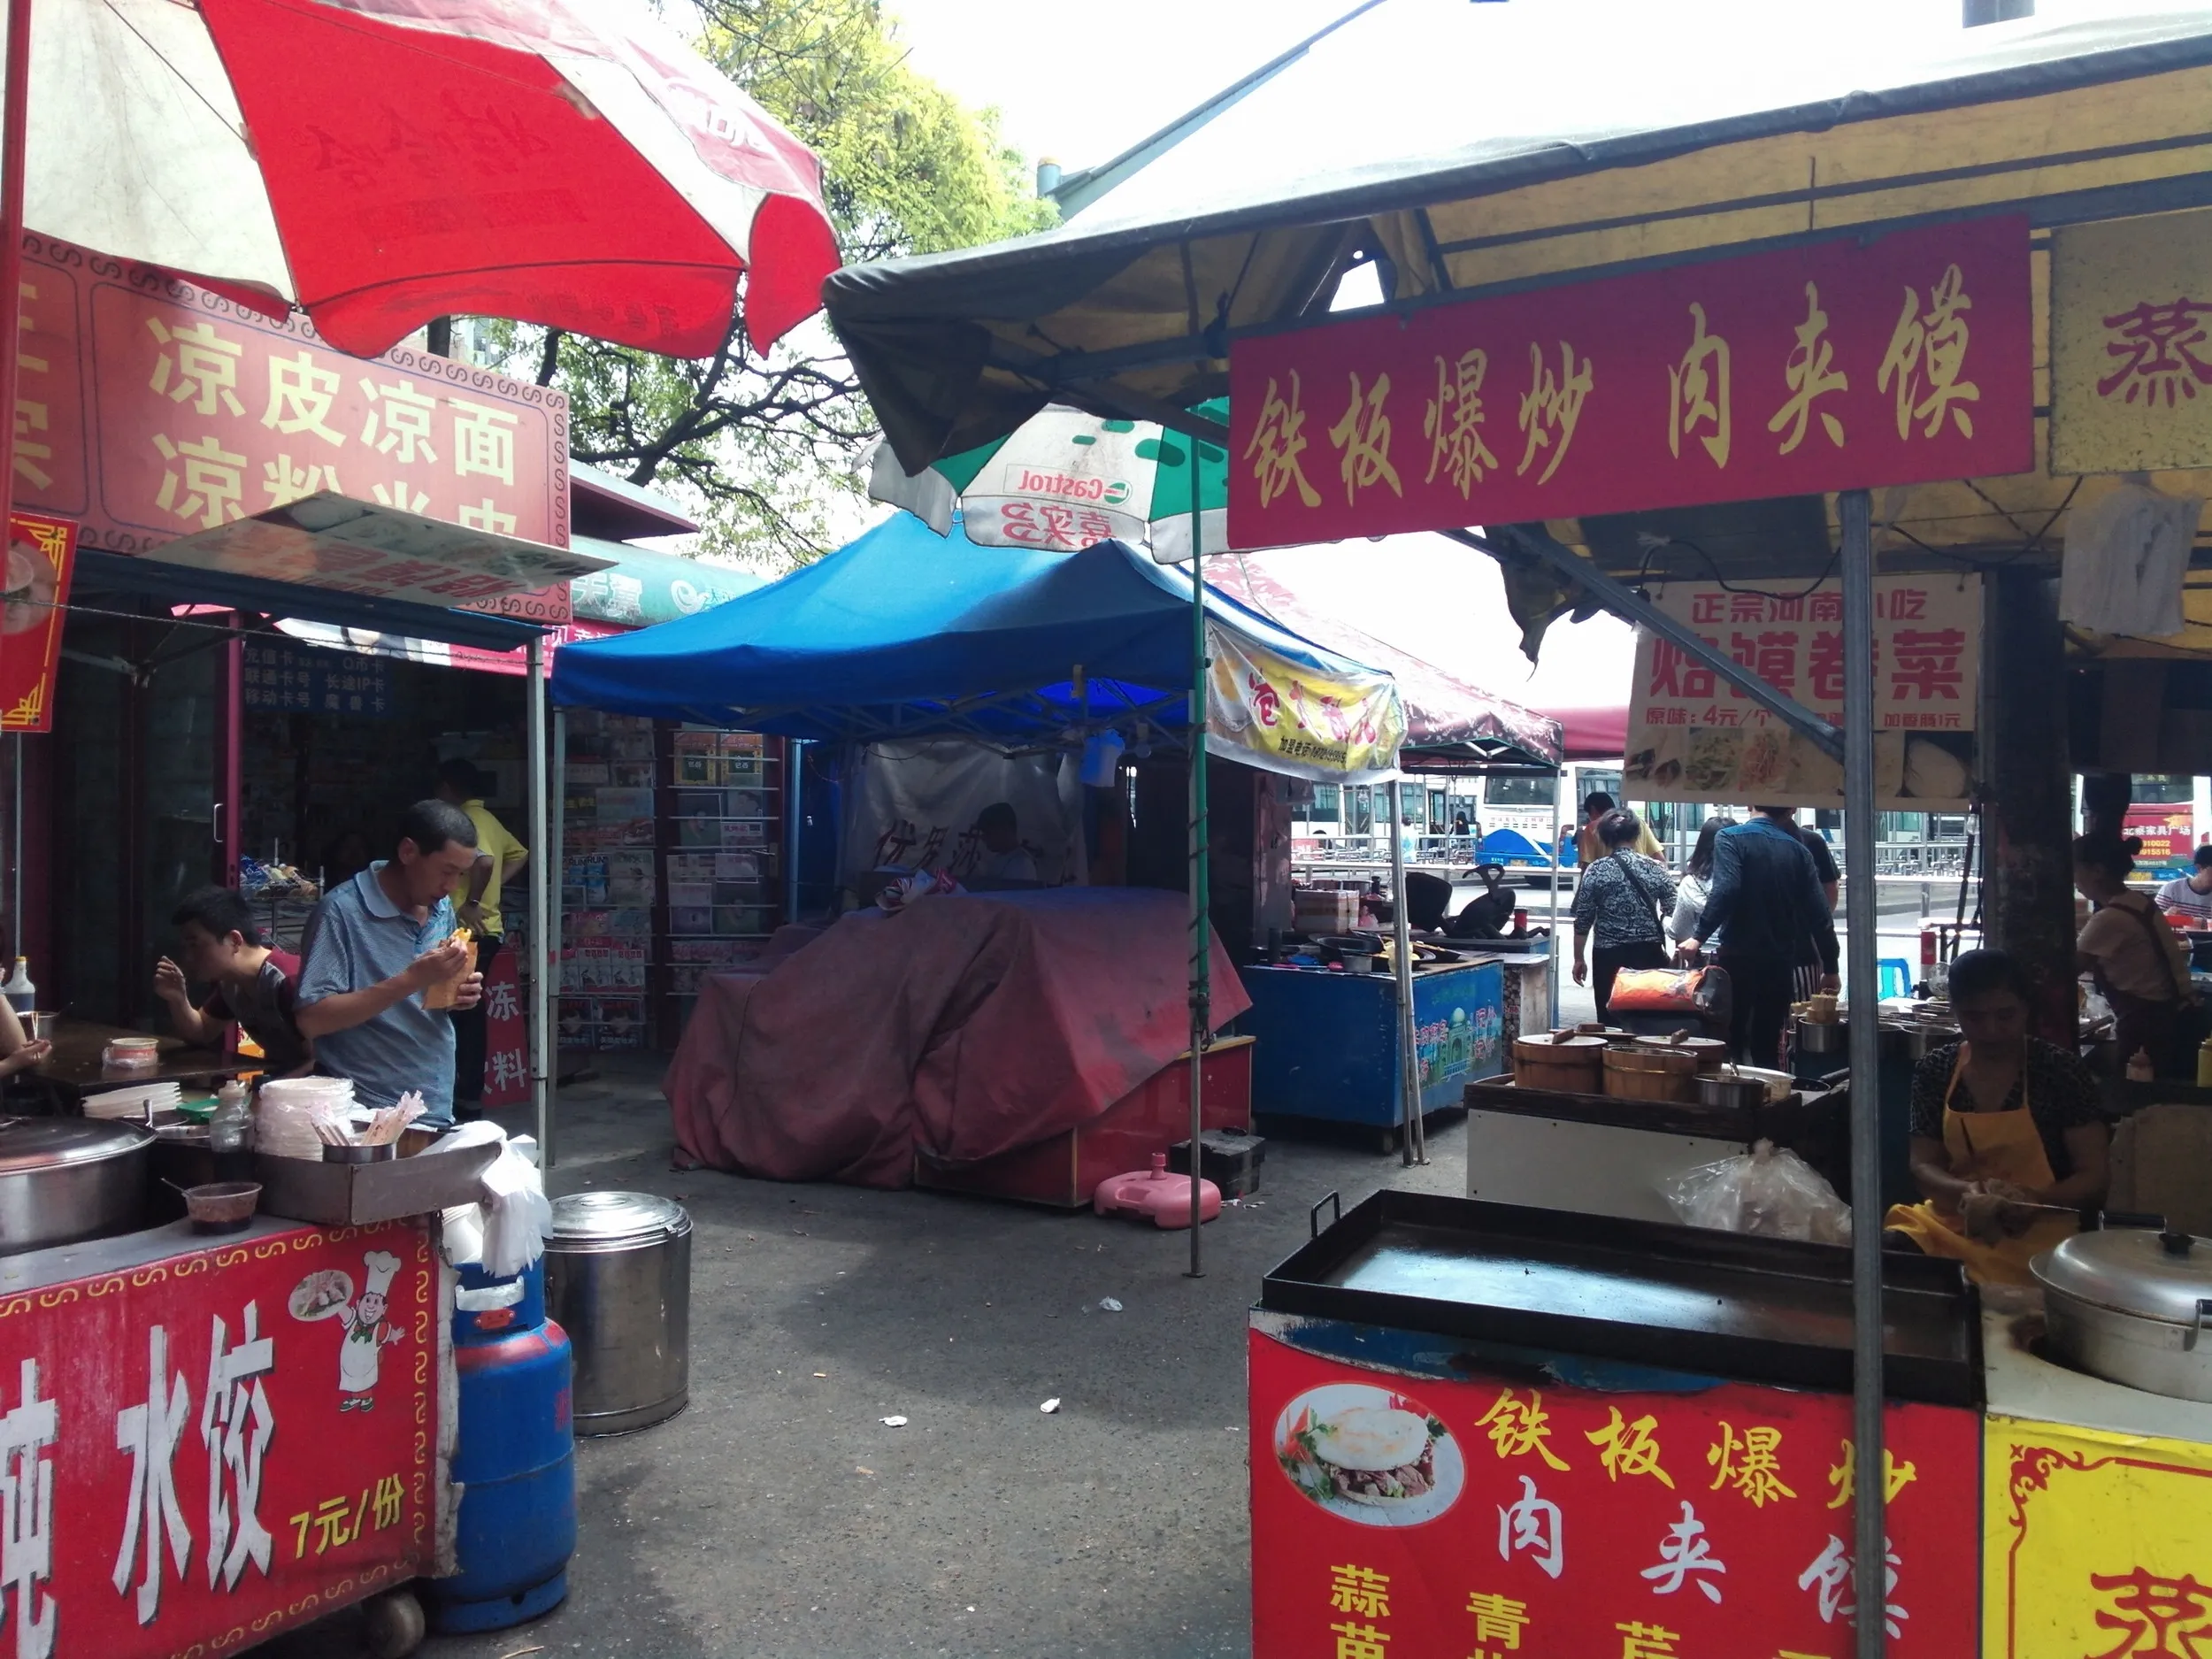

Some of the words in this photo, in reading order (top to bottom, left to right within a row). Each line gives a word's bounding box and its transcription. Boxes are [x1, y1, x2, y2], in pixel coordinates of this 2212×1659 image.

[146, 317, 518, 486] 凉皮凉面
[1244, 342, 1593, 509] 铁板爆炒
[1668, 264, 1980, 469] 肉夹馍
[2097, 296, 2212, 408] 蒸
[1693, 589, 1928, 624] 正宗河南吃
[112, 1299, 274, 1624] 水饺
[1475, 1387, 1916, 1509] 铁板爆炒
[290, 1473, 404, 1559] 7元/份
[1497, 1475, 1909, 1640] 肉夹馍
[1466, 1592, 1531, 1659] 青
